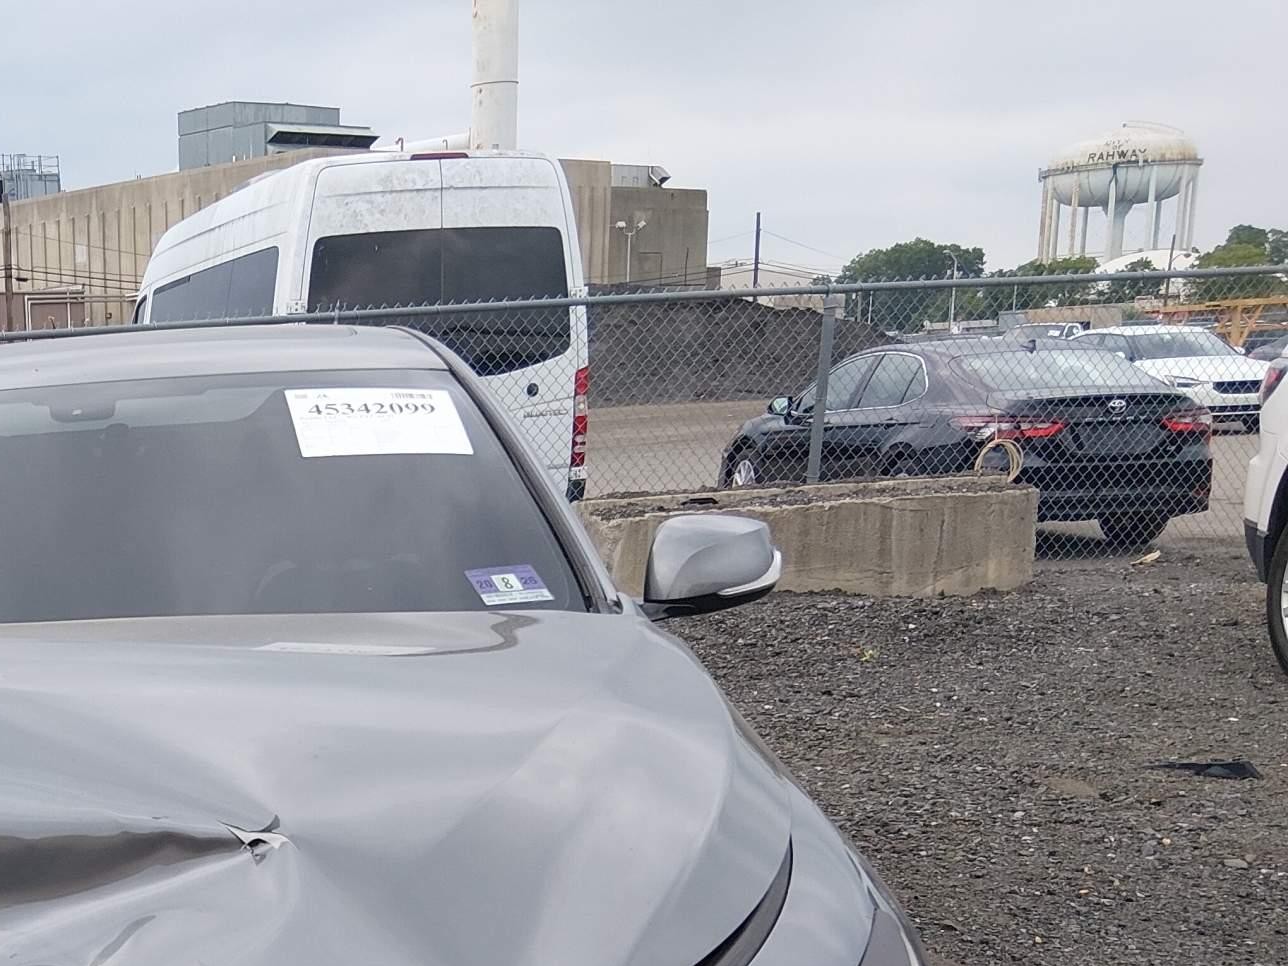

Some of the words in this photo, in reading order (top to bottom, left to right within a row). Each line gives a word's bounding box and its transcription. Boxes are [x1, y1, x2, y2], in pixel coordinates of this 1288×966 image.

[1087, 147, 1148, 163] RAHWAY
[308, 402, 436, 416] 45342099
[501, 576, 514, 590] 8
